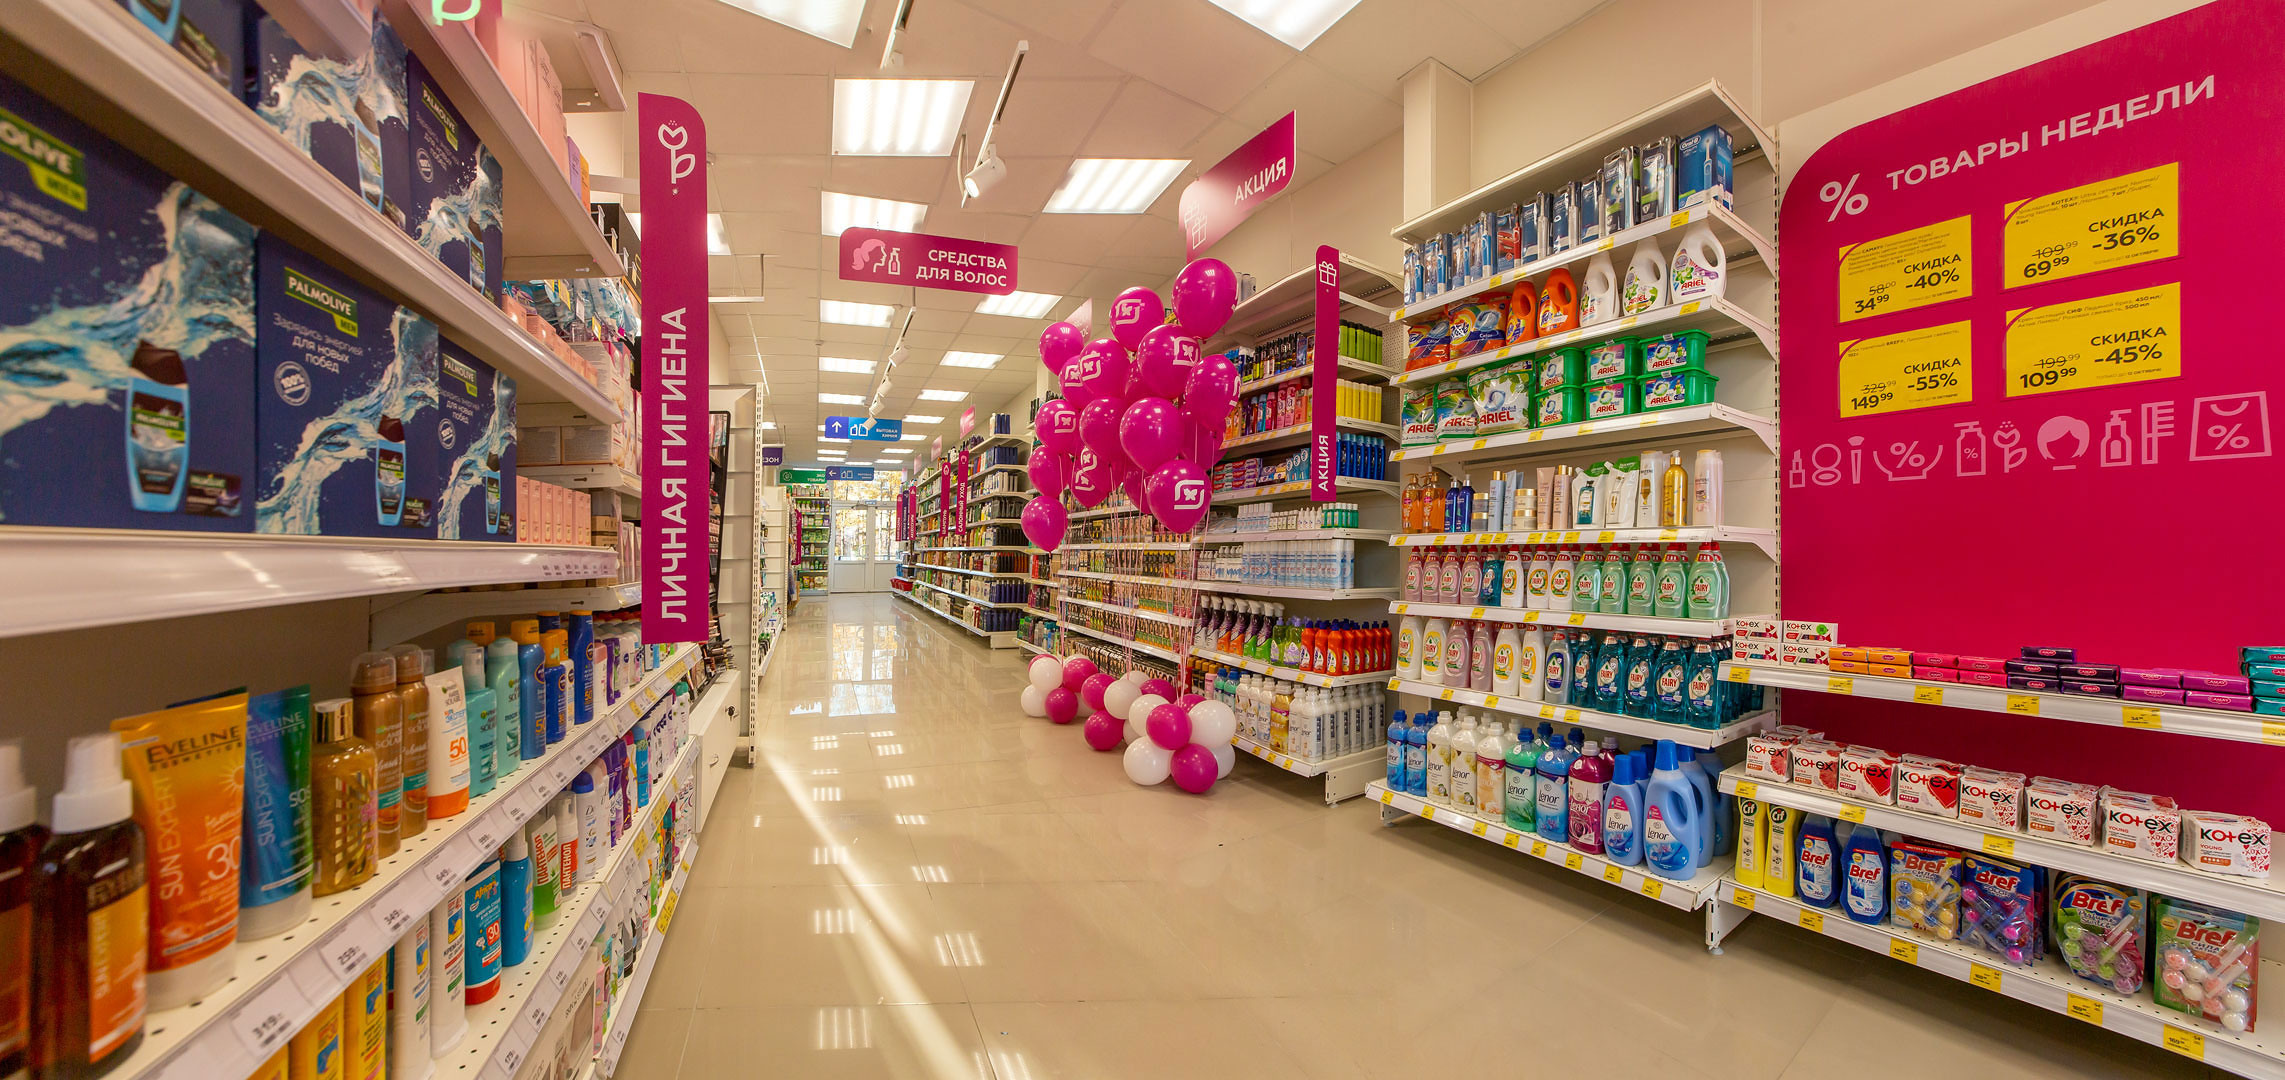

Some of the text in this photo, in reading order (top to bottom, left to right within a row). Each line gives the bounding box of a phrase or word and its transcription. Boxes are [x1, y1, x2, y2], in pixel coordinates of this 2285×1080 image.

[1886, 74, 2215, 191] ТОВАРЫ НЕДЕЛИ
[1234, 157, 1286, 205] АКЦИЯ
[2088, 208, 2164, 233] СКИДКА
[2092, 225, 2160, 250] -36%
[928, 249, 1007, 270] СРЕДСТВА
[1904, 254, 1961, 273] СКИДКА
[916, 266, 1007, 287] ДЛЯ ВОЛОС
[1681, 280, 1706, 289] ARIEL
[1906, 268, 1959, 288] -40%
[288, 276, 351, 316] PALMOLIVE
[340, 320, 356, 333] MEN
[2090, 326, 2166, 347] СКИДКА
[292, 336, 350, 364] для новых
[2094, 343, 2162, 364] -45%
[305, 353, 340, 374] побед
[444, 360, 474, 382] PALMOLIVE
[1598, 366, 1618, 375] ARIEL
[1652, 359, 1674, 369] ARIEL
[1904, 358, 1961, 374] СКИДКА
[1908, 372, 1957, 391] -55%
[1596, 404, 1617, 413] ARIEL
[1651, 395, 1672, 405] ARIEL
[1479, 411, 1514, 425] ARIEL
[1407, 424, 1436, 434] ARIE
[660, 306, 687, 623] ЛИЧНАЯ ГИГИЕНА
[1318, 435, 1328, 492] АКЦИЯ
[1579, 581, 1591, 589] FAIRY
[1661, 583, 1674, 591] FAIRY
[1695, 584, 1709, 592] FAIRY
[1497, 656, 1507, 664] FAIRY
[1548, 665, 1560, 674] FAIRY
[1600, 670, 1615, 678] FAIRY
[1630, 673, 1643, 682] FAIRY
[1661, 677, 1677, 688] FAIRY
[1693, 681, 1708, 691] FAIRY
[247, 712, 302, 738] EVELINE
[147, 725, 241, 764] EVELINE
[450, 736, 467, 759] 50
[1428, 760, 1444, 771] Lenor
[1452, 768, 1470, 779] Lenor
[1507, 783, 1528, 795] Lenor
[1539, 790, 1559, 804] Lenor
[252, 750, 275, 846] SUN EXPERT
[1570, 800, 1591, 813] Lenor
[1742, 803, 1755, 814] Cif
[1772, 809, 1786, 821] Cif
[1608, 816, 1628, 830] Lenor
[154, 777, 183, 900] SUN EXPERT
[1648, 827, 1669, 841] Lenor
[534, 834, 550, 885] ПАНТЕНОЛ
[562, 843, 572, 889] ПАНТЕНОЛ
[1801, 850, 1830, 865] Bref
[1905, 854, 1946, 874] Bref
[1849, 864, 1881, 880] Bref
[1975, 871, 2019, 891] Bref
[475, 880, 496, 900] African
[2071, 892, 2125, 915] Bref
[487, 923, 499, 941] 30
[2176, 920, 2237, 948] Bref
[2190, 940, 2221, 951] СИЛА
